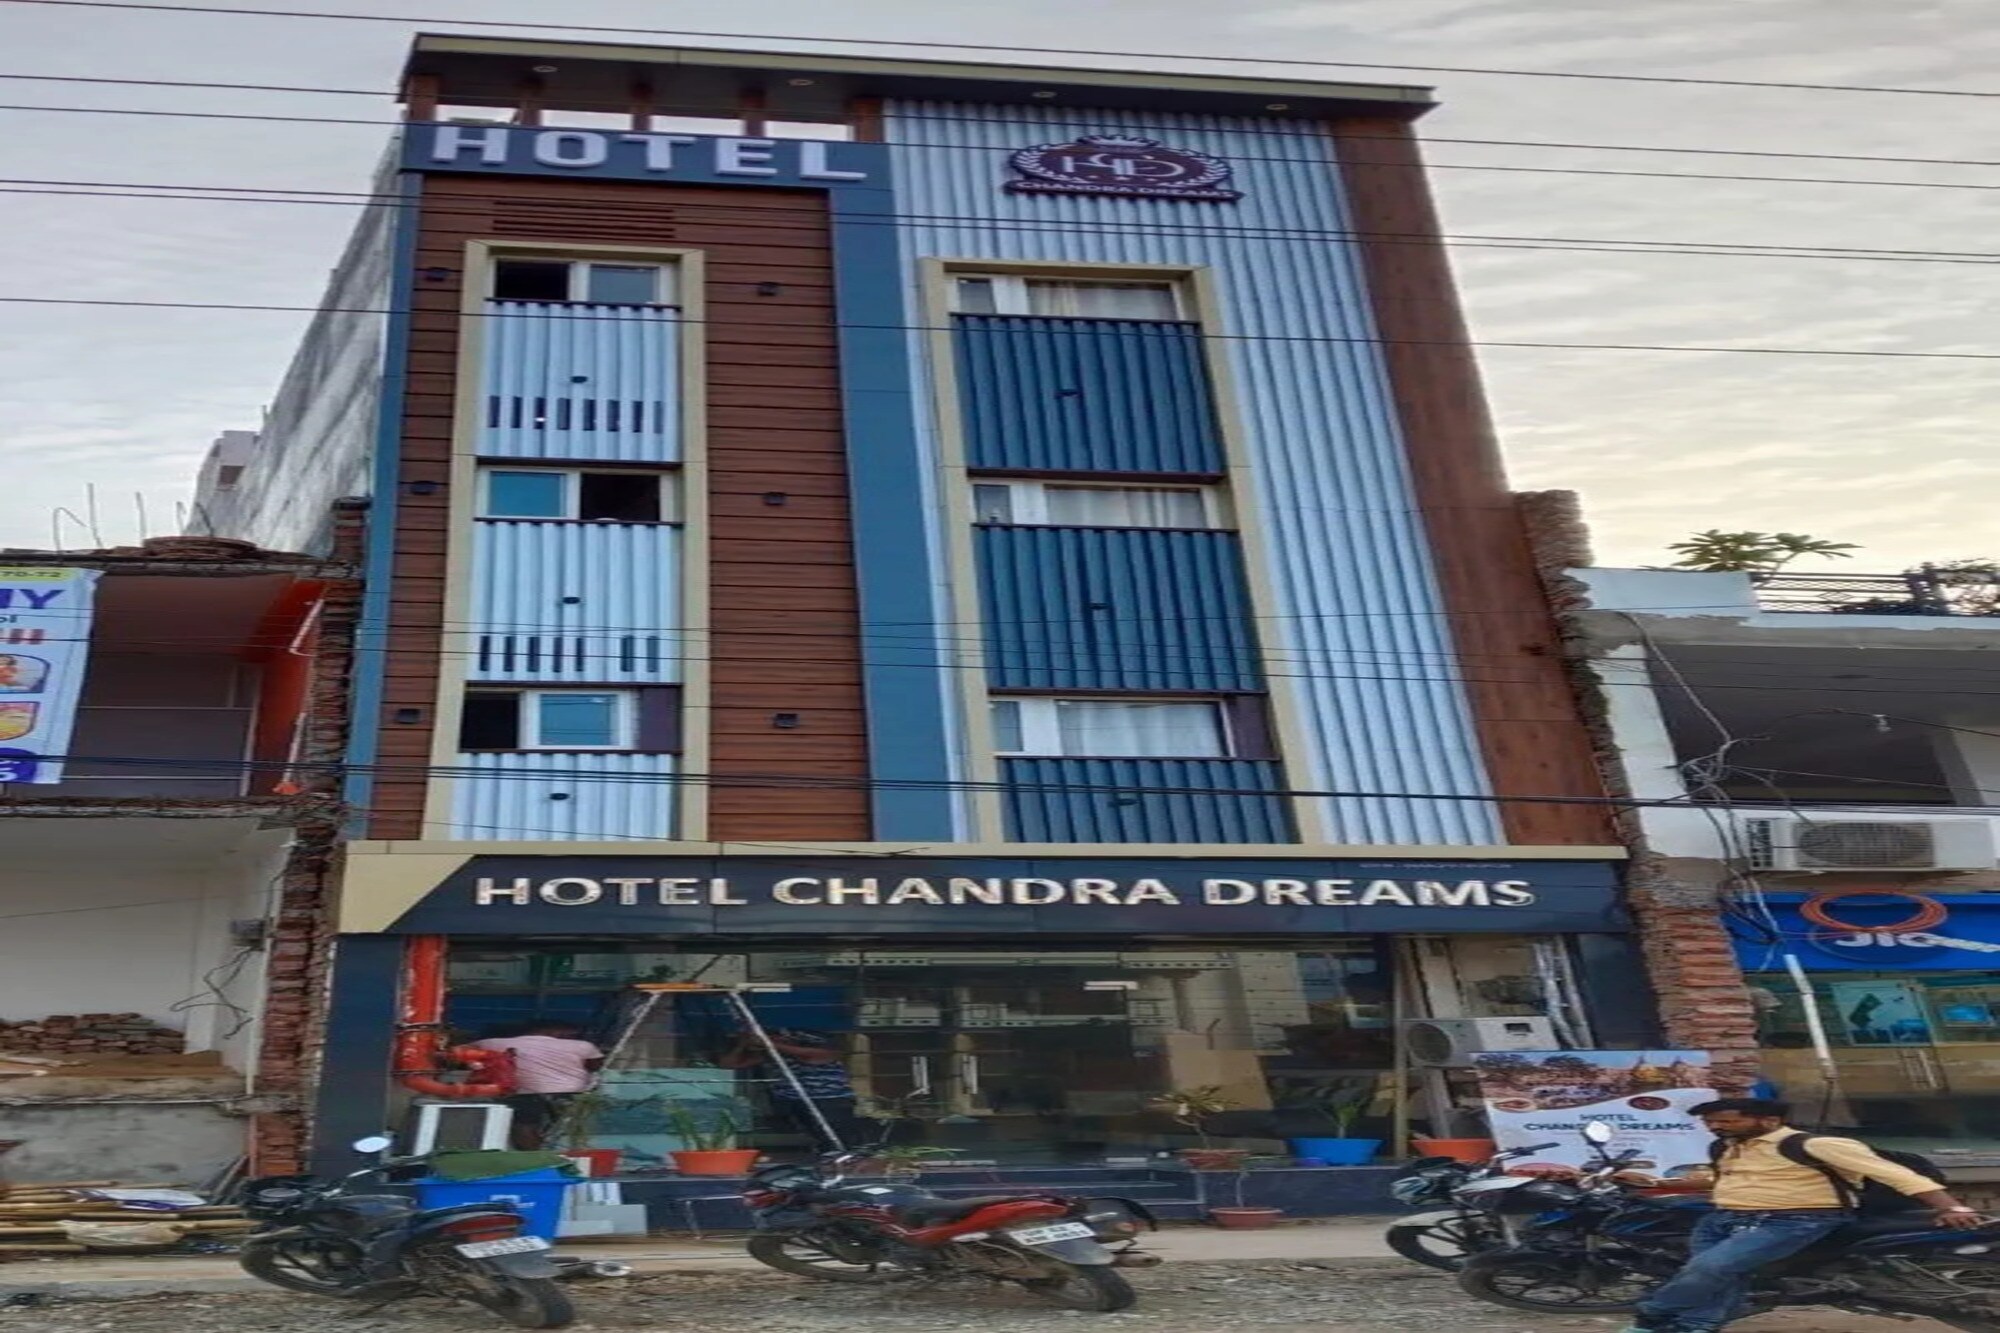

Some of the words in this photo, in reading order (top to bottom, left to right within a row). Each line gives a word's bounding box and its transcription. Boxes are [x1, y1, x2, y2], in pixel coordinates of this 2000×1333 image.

[432, 126, 867, 181] HOTEL
[1015, 181, 1134, 193] CHANDRA
[1138, 186, 1235, 198] DREAMS
[475, 876, 748, 906] HOTEL
[771, 876, 1181, 906] CHANDRA
[1201, 877, 1537, 907] DREAMS
[1619, 1122, 1696, 1131] DREAMS
